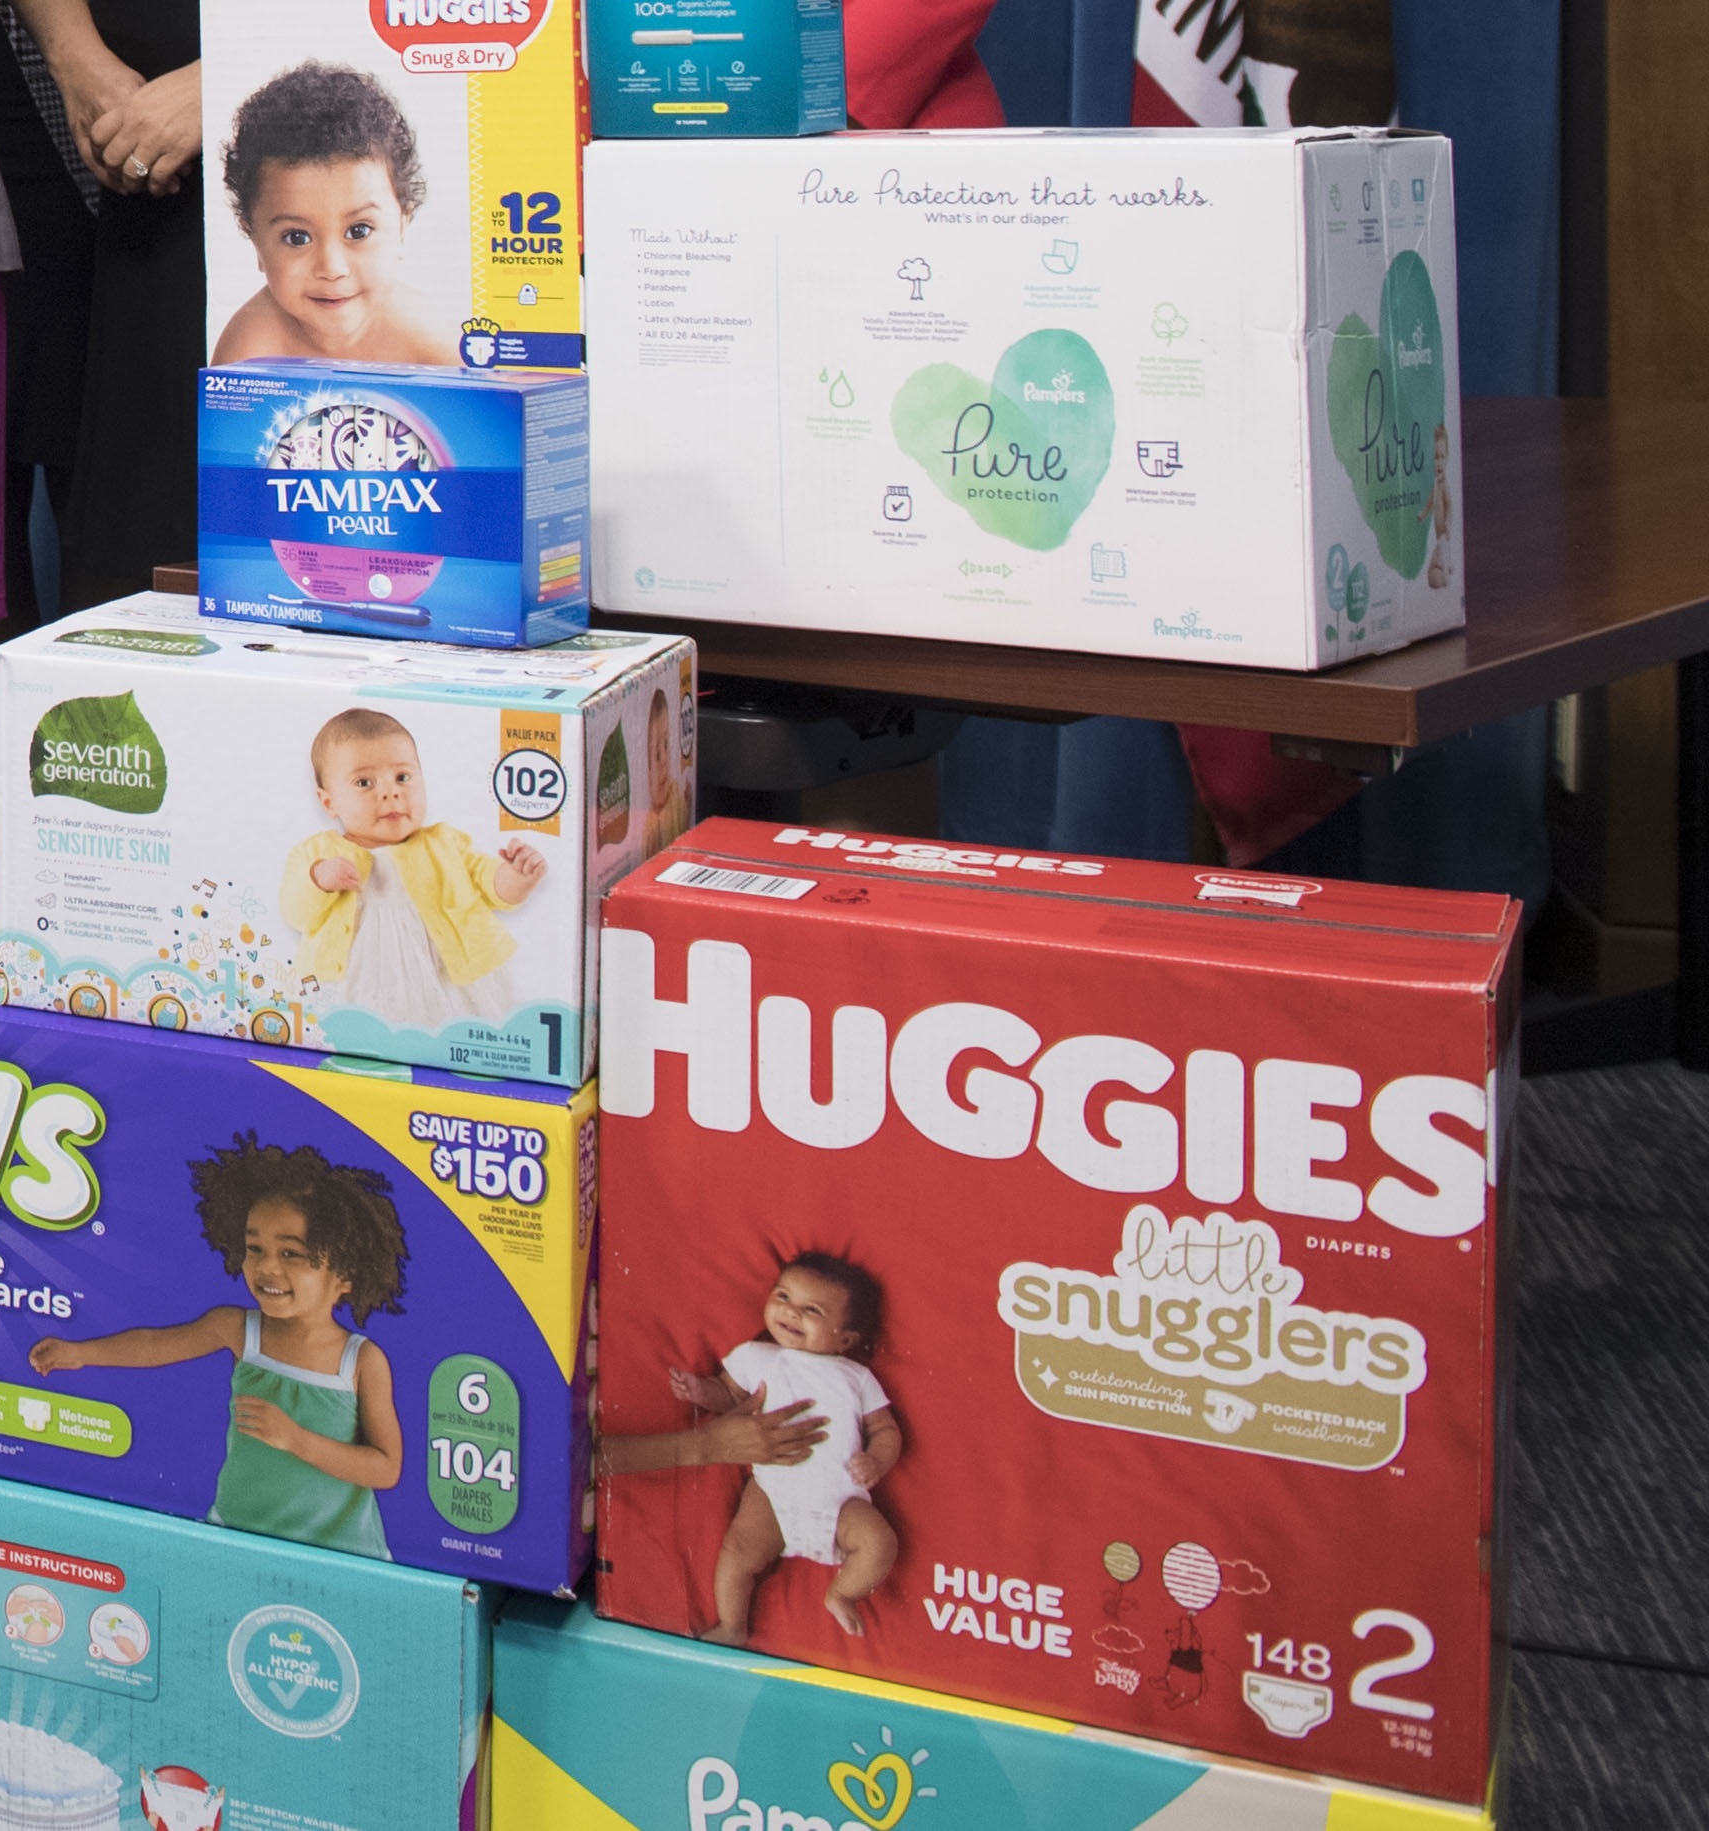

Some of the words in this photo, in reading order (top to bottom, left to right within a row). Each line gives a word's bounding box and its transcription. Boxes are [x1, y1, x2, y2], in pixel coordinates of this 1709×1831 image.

[634, 1, 674, 16] 100%
[676, 0, 704, 9] Organic
[411, 50, 453, 68] Snug
[457, 49, 470, 64] &
[473, 49, 506, 67] Dry
[797, 168, 859, 205] Pure
[874, 168, 1018, 206] Protection
[1031, 177, 1096, 206] that
[1110, 177, 1214, 207] works.
[491, 211, 505, 219] UP
[492, 219, 505, 227] TO
[500, 192, 562, 234] 12
[924, 211, 972, 224] What's
[975, 212, 989, 224] in
[992, 215, 1016, 225] our
[1019, 213, 1070, 226] diaper:
[492, 237, 563, 254] HOUR
[643, 252, 683, 260] Chlorine
[686, 253, 732, 262] Bleaching
[492, 256, 563, 265] PROTECTION
[643, 267, 690, 277] Fragrance
[644, 283, 687, 292] Parabens
[644, 299, 675, 307] Lotion
[1024, 381, 1085, 405] Pampers
[941, 403, 1067, 481] Pure
[266, 477, 443, 513] TAMPAX
[968, 487, 1059, 502] protection
[368, 565, 430, 577] PROTECTION
[204, 597, 216, 611] 36
[225, 600, 323, 624] TAMPONS/TAMPONES
[506, 728, 532, 740] VALUE
[534, 729, 557, 742] PACK
[43, 739, 152, 771] seventh
[503, 766, 558, 798] 102
[510, 797, 550, 810] diapers
[37, 828, 125, 861] SENSITIVE
[129, 839, 171, 866] SKIN
[773, 828, 1105, 876] HUGGIES
[64, 896, 88, 906] ULTRA
[89, 899, 135, 911] ABSORBENT
[136, 904, 158, 913] CORE
[539, 1012, 561, 1076] 1
[600, 927, 1488, 1238] HUGGIES
[412, 1113, 472, 1145] SAVE
[476, 1124, 510, 1149] UP
[511, 1128, 543, 1155] TO
[433, 1145, 543, 1202] $150
[478, 1213, 520, 1228] CHOOSING
[521, 1220, 543, 1231] LUVS
[491, 1205, 507, 1215] PER
[509, 1209, 530, 1219] YEAR
[531, 1211, 542, 1220] BY
[1127, 1216, 1289, 1295] little
[1306, 1235, 1392, 1260] DIAPERS
[1011, 1274, 1410, 1381] snugglers
[457, 1372, 491, 1415] 6
[1068, 1368, 1187, 1401] outstanding
[1064, 1384, 1099, 1403] SKIN
[1101, 1390, 1192, 1417] PROTECTION
[58, 1408, 111, 1430] Wetness
[1262, 1403, 1343, 1424] POCKETED
[1345, 1415, 1387, 1434] BACK
[58, 1422, 114, 1444] Indicator
[1273, 1420, 1375, 1449] waistband
[431, 1437, 516, 1492] 104
[452, 1485, 493, 1507] DIAPERS
[451, 1501, 493, 1524] PAÑALES
[9, 1550, 117, 1586] INSTRUCTIONS:
[933, 1563, 1066, 1618] HUGE
[922, 1597, 1074, 1658] VALUE
[269, 1632, 312, 1656] Pampers
[1246, 1632, 1331, 1681] 148
[1351, 1608, 1435, 1719] 2
[247, 1662, 339, 1693] ALLERGENIC
[1094, 1670, 1141, 1695] baby
